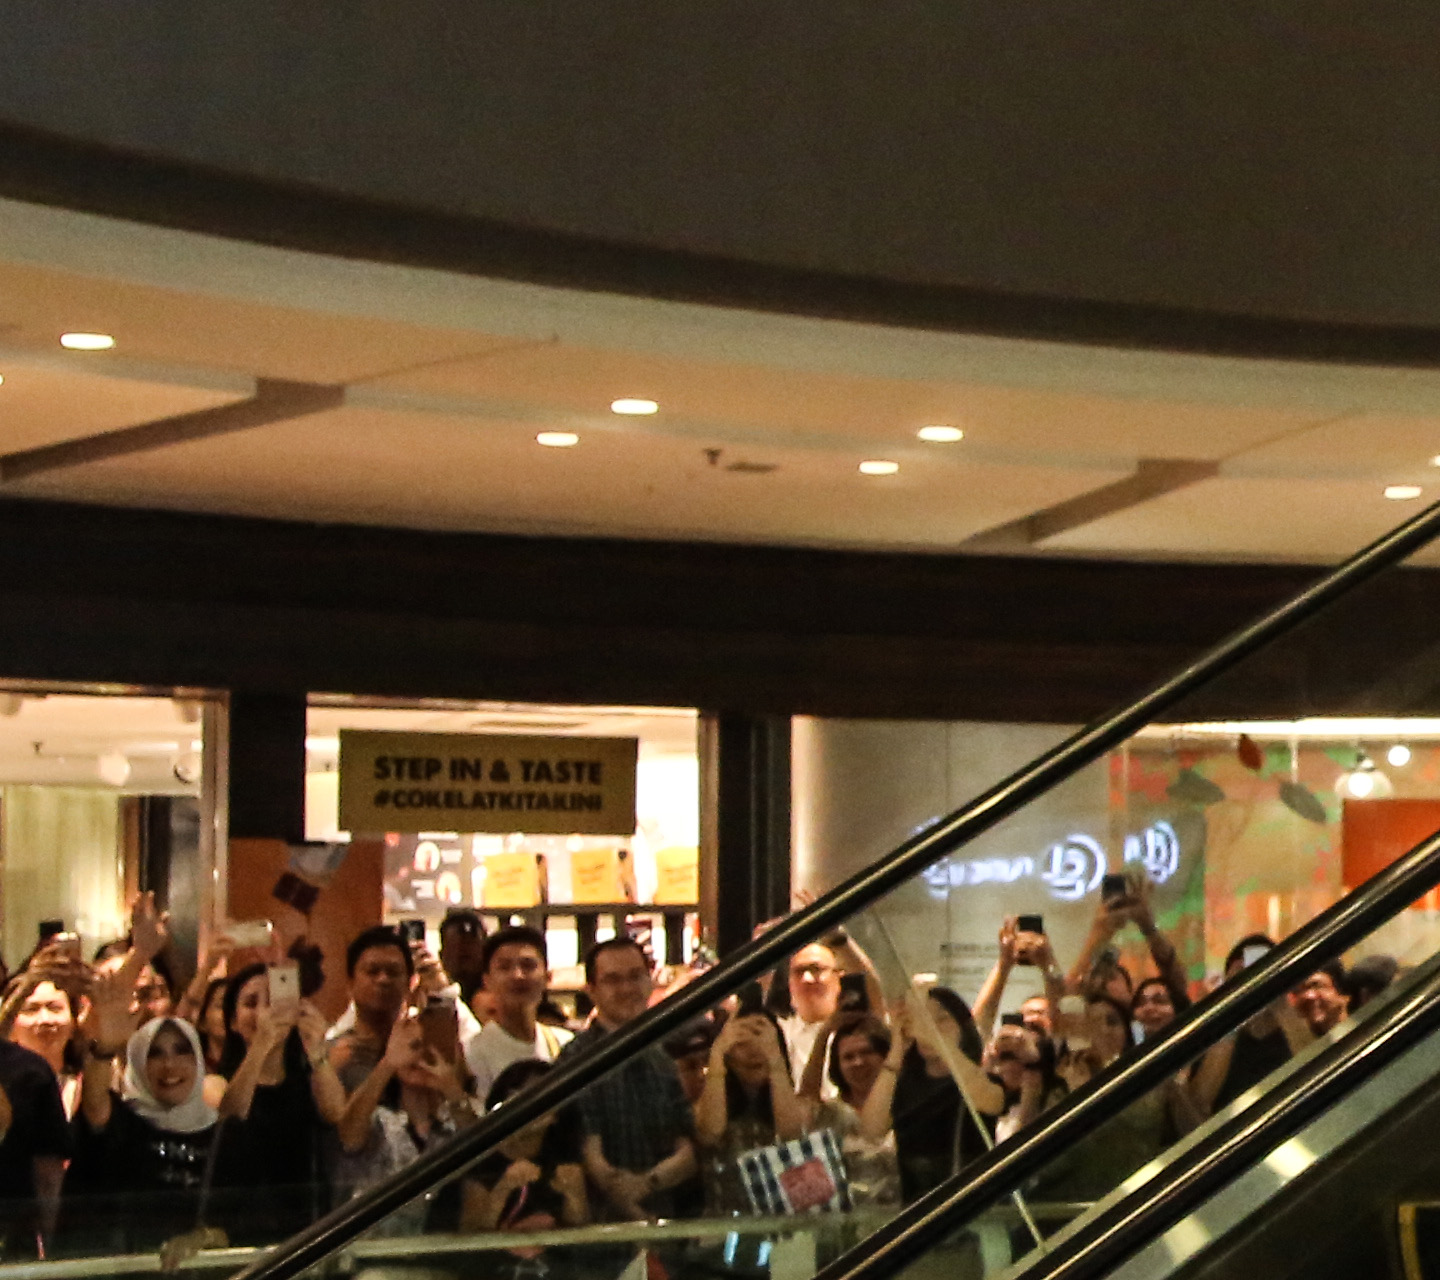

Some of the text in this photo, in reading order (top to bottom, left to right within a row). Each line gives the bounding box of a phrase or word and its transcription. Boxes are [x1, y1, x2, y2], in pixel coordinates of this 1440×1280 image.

[374, 756, 603, 785] STEP IN & TASTE
[373, 789, 603, 812] #COKELATKITAKINI
